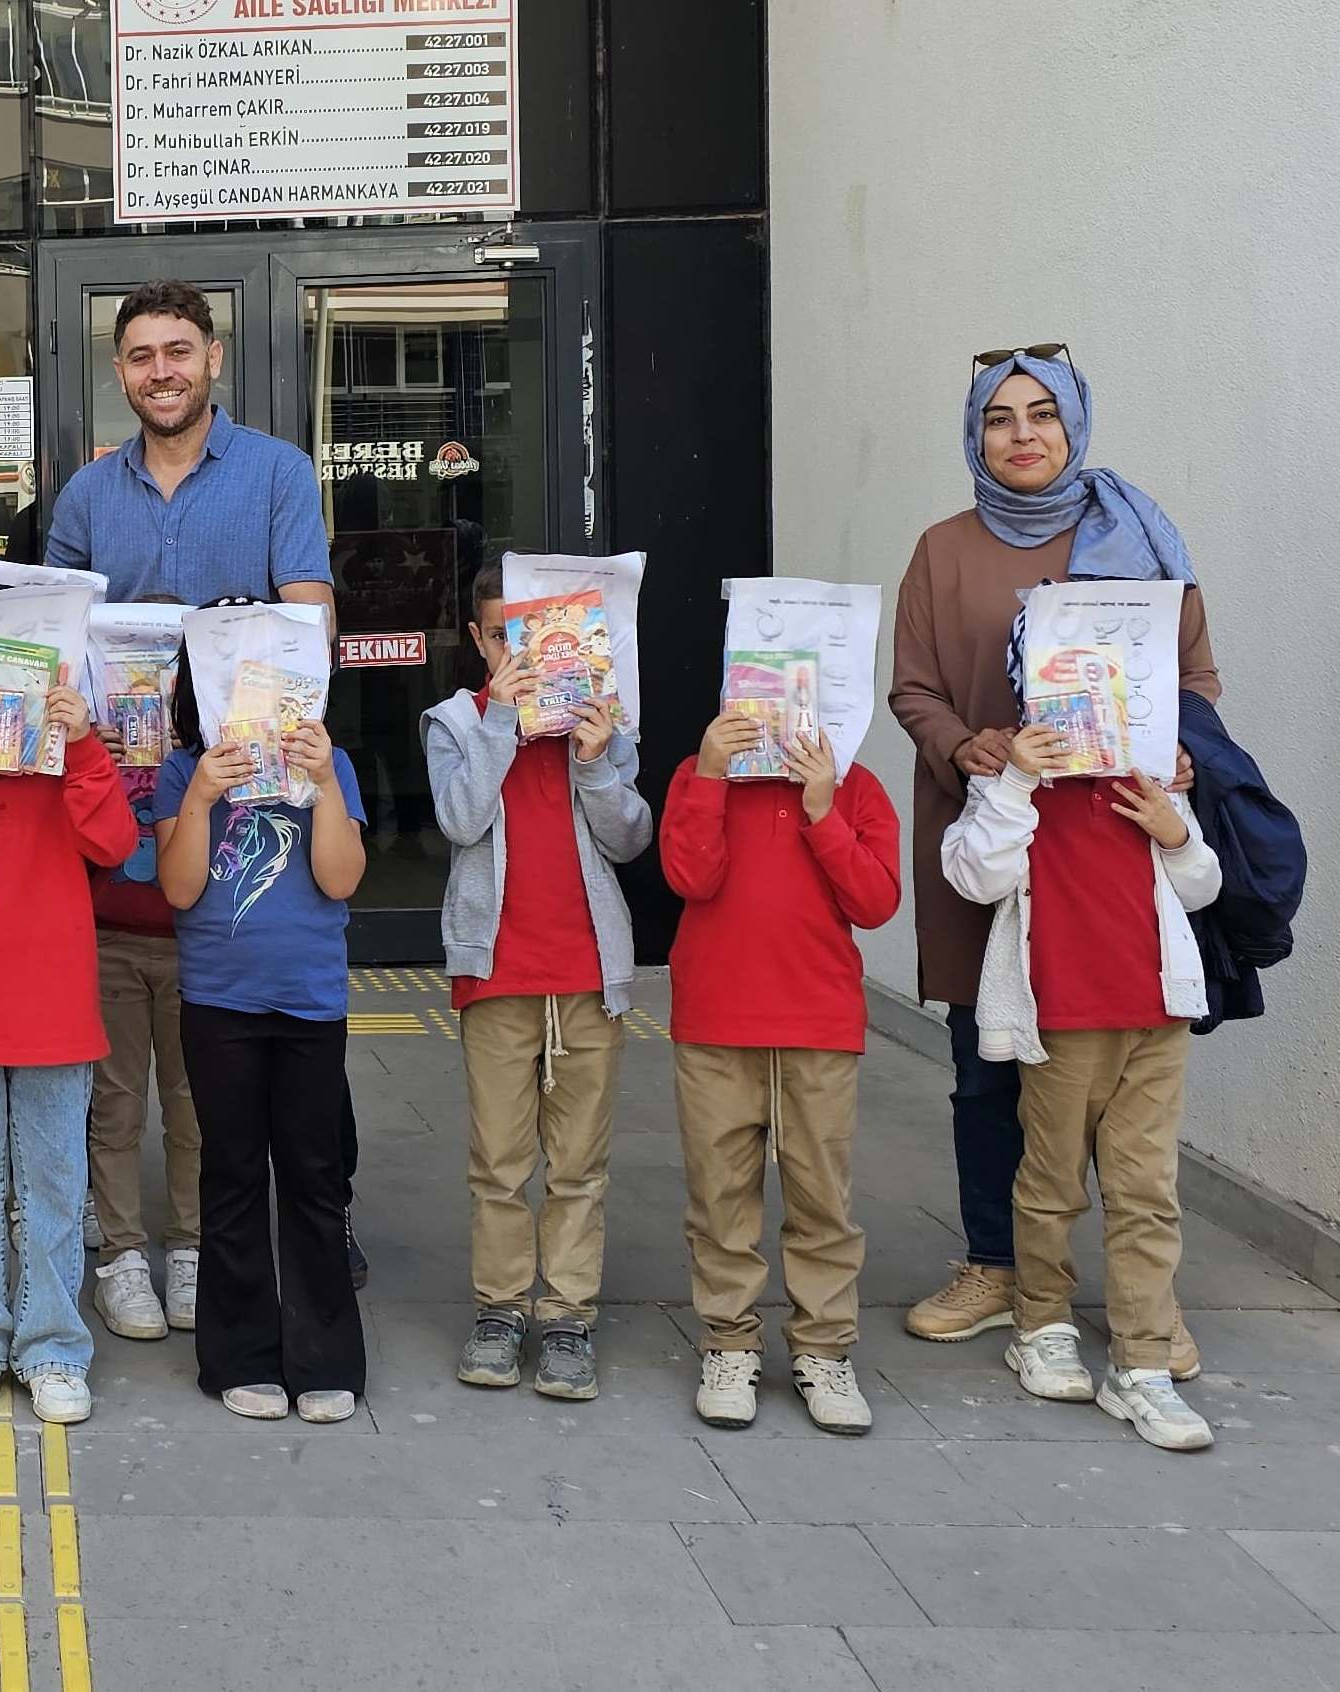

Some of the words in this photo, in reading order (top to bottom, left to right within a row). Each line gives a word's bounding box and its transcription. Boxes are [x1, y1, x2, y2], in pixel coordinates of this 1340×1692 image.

[425, 35, 488, 48] 42.27.001
[125, 46, 147, 61] Dr.
[152, 44, 193, 60] Nazik
[198, 39, 248, 59] ÖZKAL
[423, 64, 490, 77] 42.27.003
[126, 75, 147, 91] Dr.
[153, 73, 192, 90] Fahri
[424, 93, 490, 106] 42.27.004
[126, 105, 148, 120] Dr.
[153, 103, 232, 119] Muharrem
[424, 123, 490, 136] 42.27.019
[126, 134, 148, 149] Dr.
[154, 133, 243, 149] Muhibullah
[425, 152, 491, 165] 42.27.020
[127, 163, 149, 178] Dr.
[154, 161, 198, 177] Erhan
[426, 181, 491, 195] 42.27.021
[128, 192, 150, 207] Dr.
[154, 188, 213, 210] Ayşegül
[218, 187, 283, 204] CANDAN
[289, 183, 399, 202] HARMANKAYA
